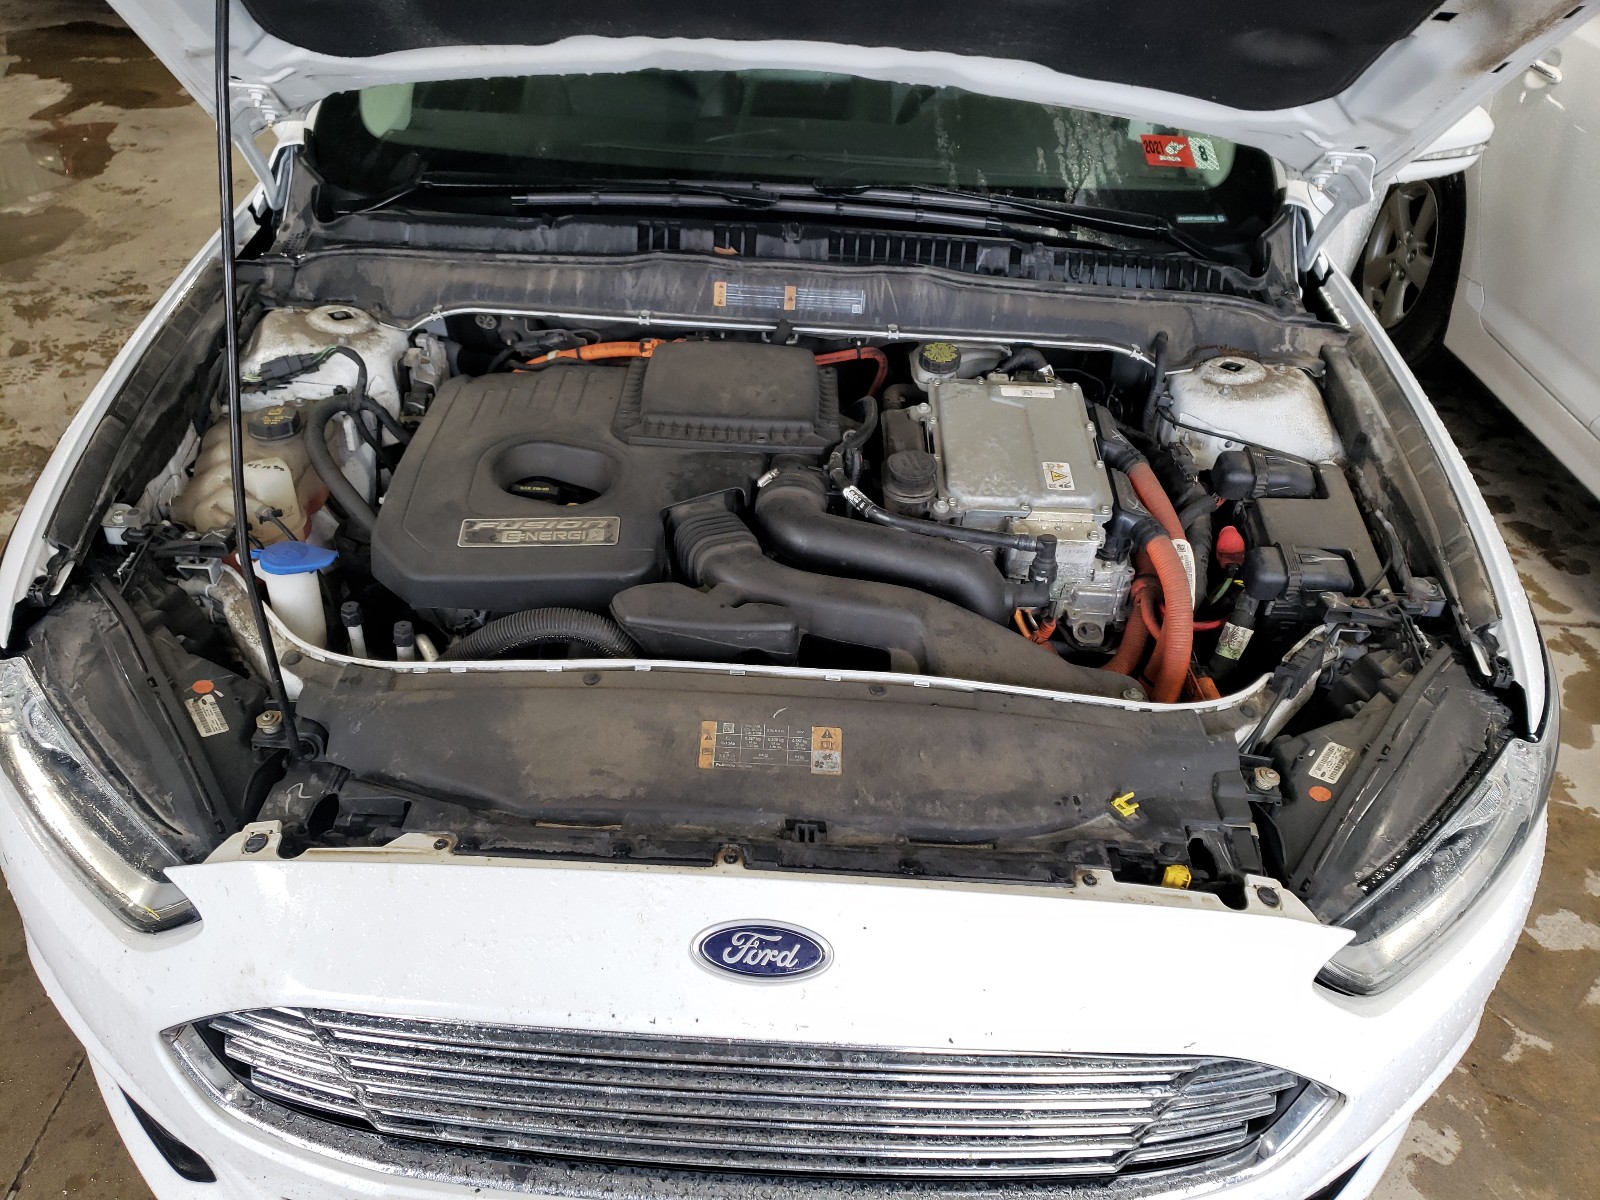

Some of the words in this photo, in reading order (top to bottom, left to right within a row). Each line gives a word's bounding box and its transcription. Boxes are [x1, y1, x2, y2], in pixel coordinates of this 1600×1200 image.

[1143, 141, 1165, 155] 2021
[1198, 145, 1208, 161] 8
[473, 520, 608, 530] FUSION
[501, 530, 586, 543] ENERGI
[722, 931, 801, 968] Ford
